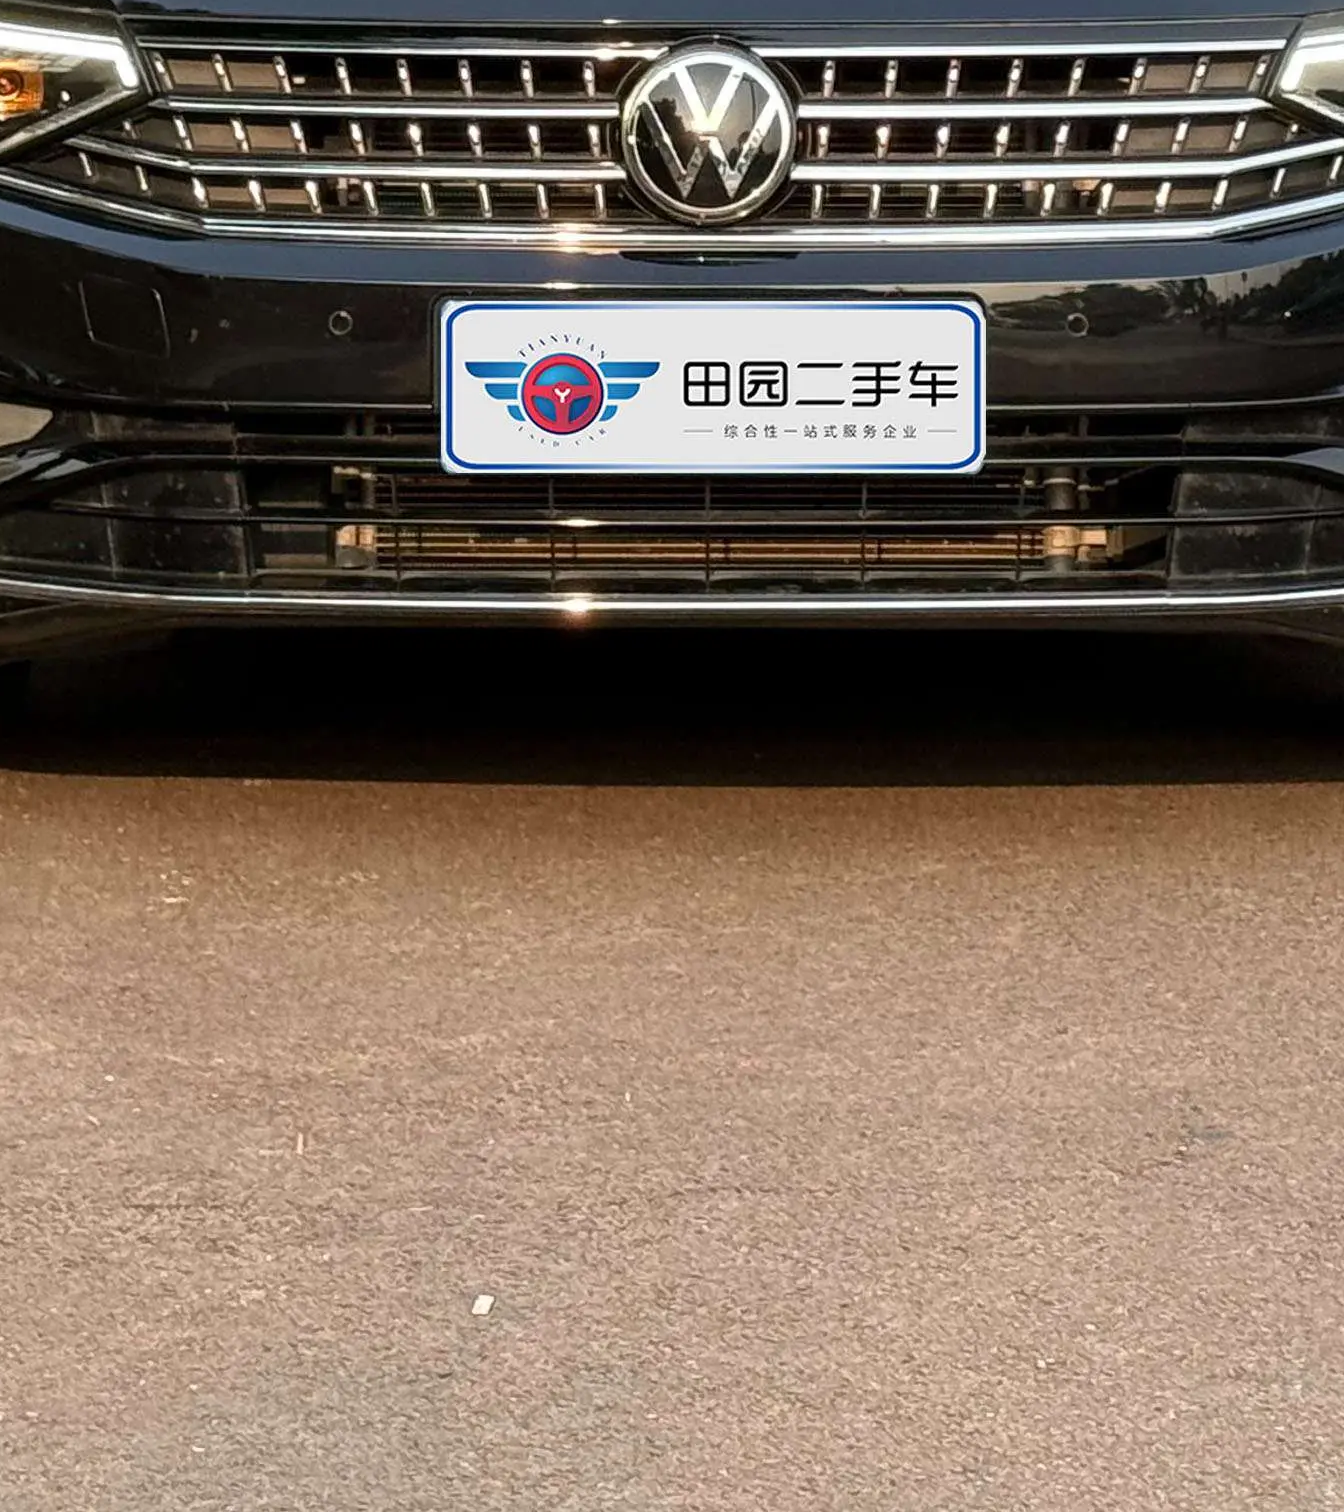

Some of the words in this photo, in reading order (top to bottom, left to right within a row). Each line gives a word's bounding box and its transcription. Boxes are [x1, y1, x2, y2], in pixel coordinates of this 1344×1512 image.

[632, 54, 786, 208] VW
[683, 360, 959, 408] 田园二手车
[723, 423, 917, 440] 综合性一站式服务企业
